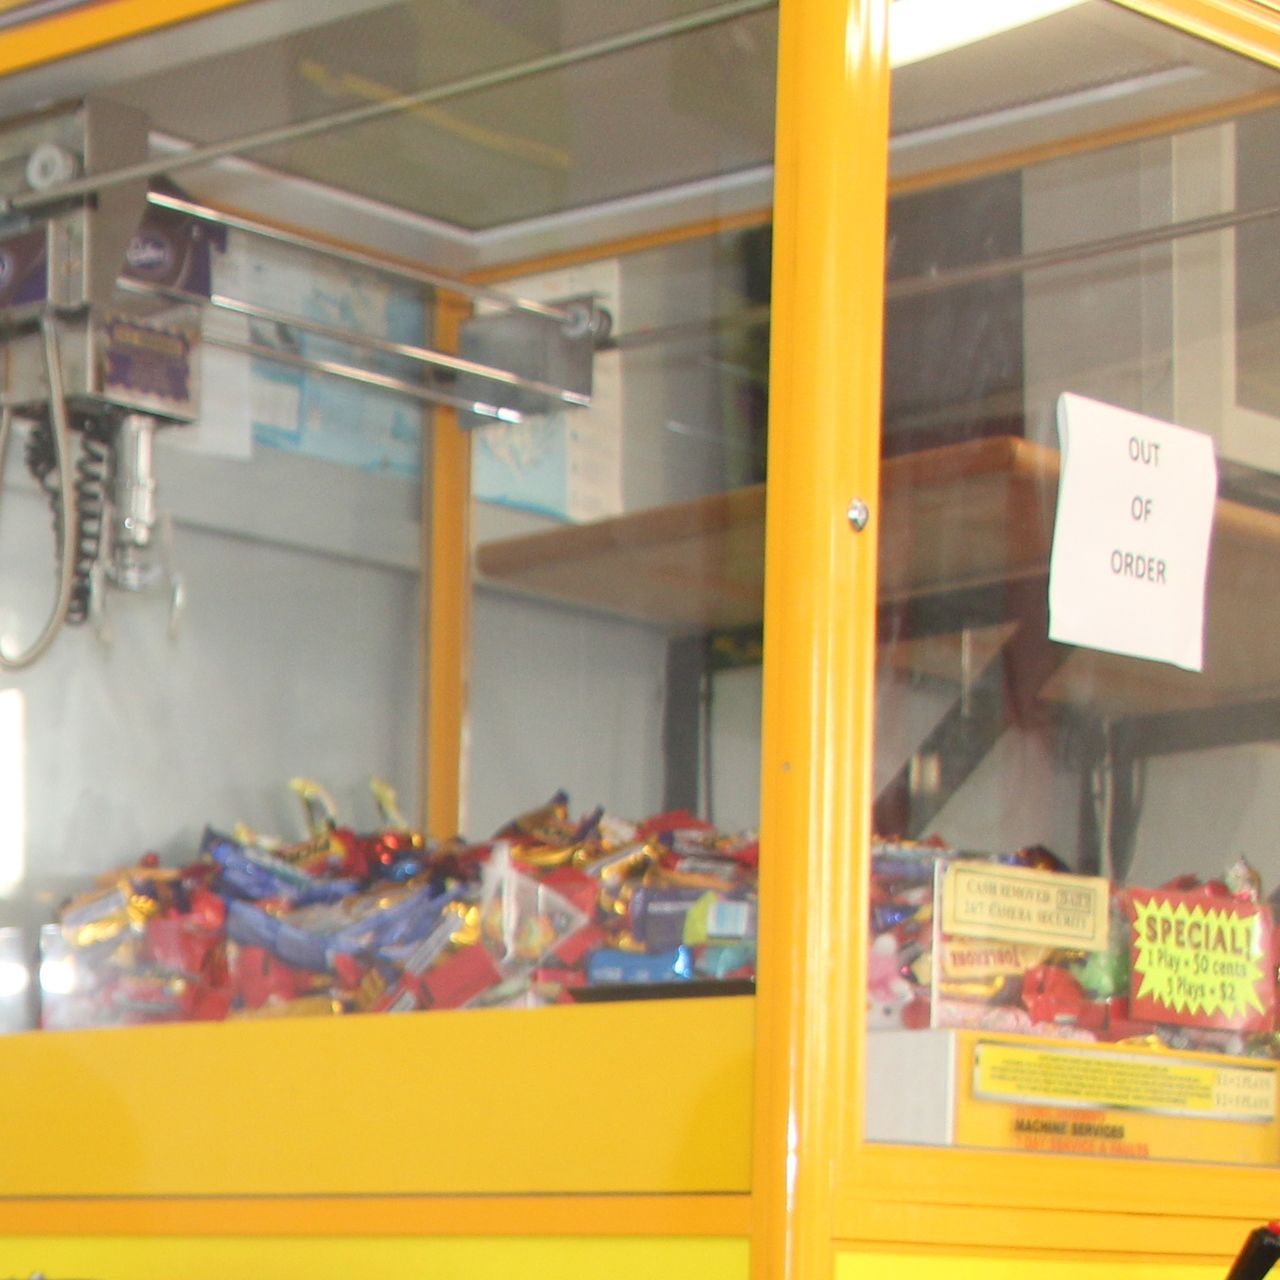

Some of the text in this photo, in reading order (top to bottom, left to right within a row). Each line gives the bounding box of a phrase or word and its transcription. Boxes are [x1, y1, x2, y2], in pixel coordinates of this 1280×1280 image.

[1128, 436, 1160, 467] OUT
[1130, 496, 1153, 523] OF
[1110, 549, 1166, 584] ORDER
[1145, 915, 1251, 961] SPECIAL!
[1158, 948, 1180, 974] Play
[1194, 952, 1209, 975] 50
[1213, 961, 1247, 977] cents
